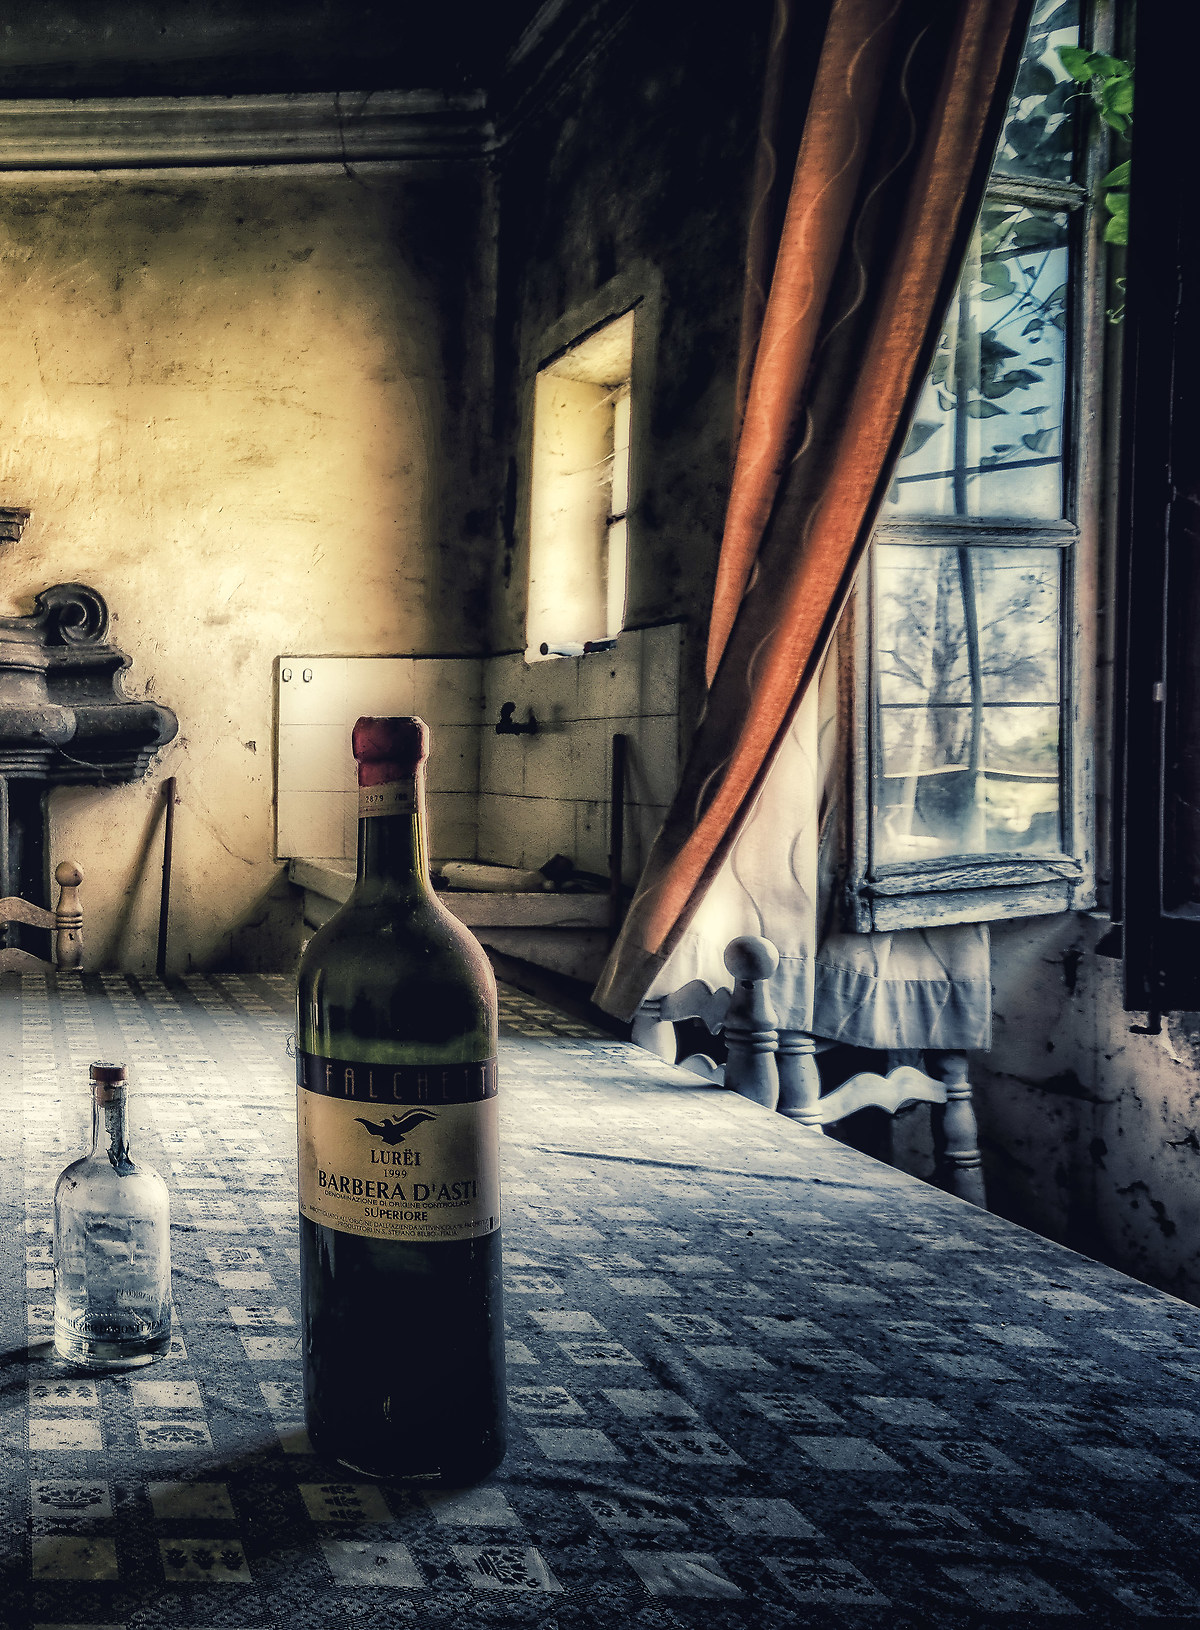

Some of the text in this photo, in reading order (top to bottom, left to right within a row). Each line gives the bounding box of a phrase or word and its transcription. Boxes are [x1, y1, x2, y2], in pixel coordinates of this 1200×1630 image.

[325, 1062, 498, 1099] FALCHETTO
[370, 1148, 421, 1166] LURËI
[384, 1168, 407, 1179] 1999
[318, 1169, 478, 1202] BARBERA D'ASTI
[324, 1189, 378, 1206] DENOMINAZIONE
[388, 1200, 420, 1209] ORIGINE
[422, 1200, 471, 1209] CONTROLLATA
[364, 1206, 428, 1221] SUPERIORE
